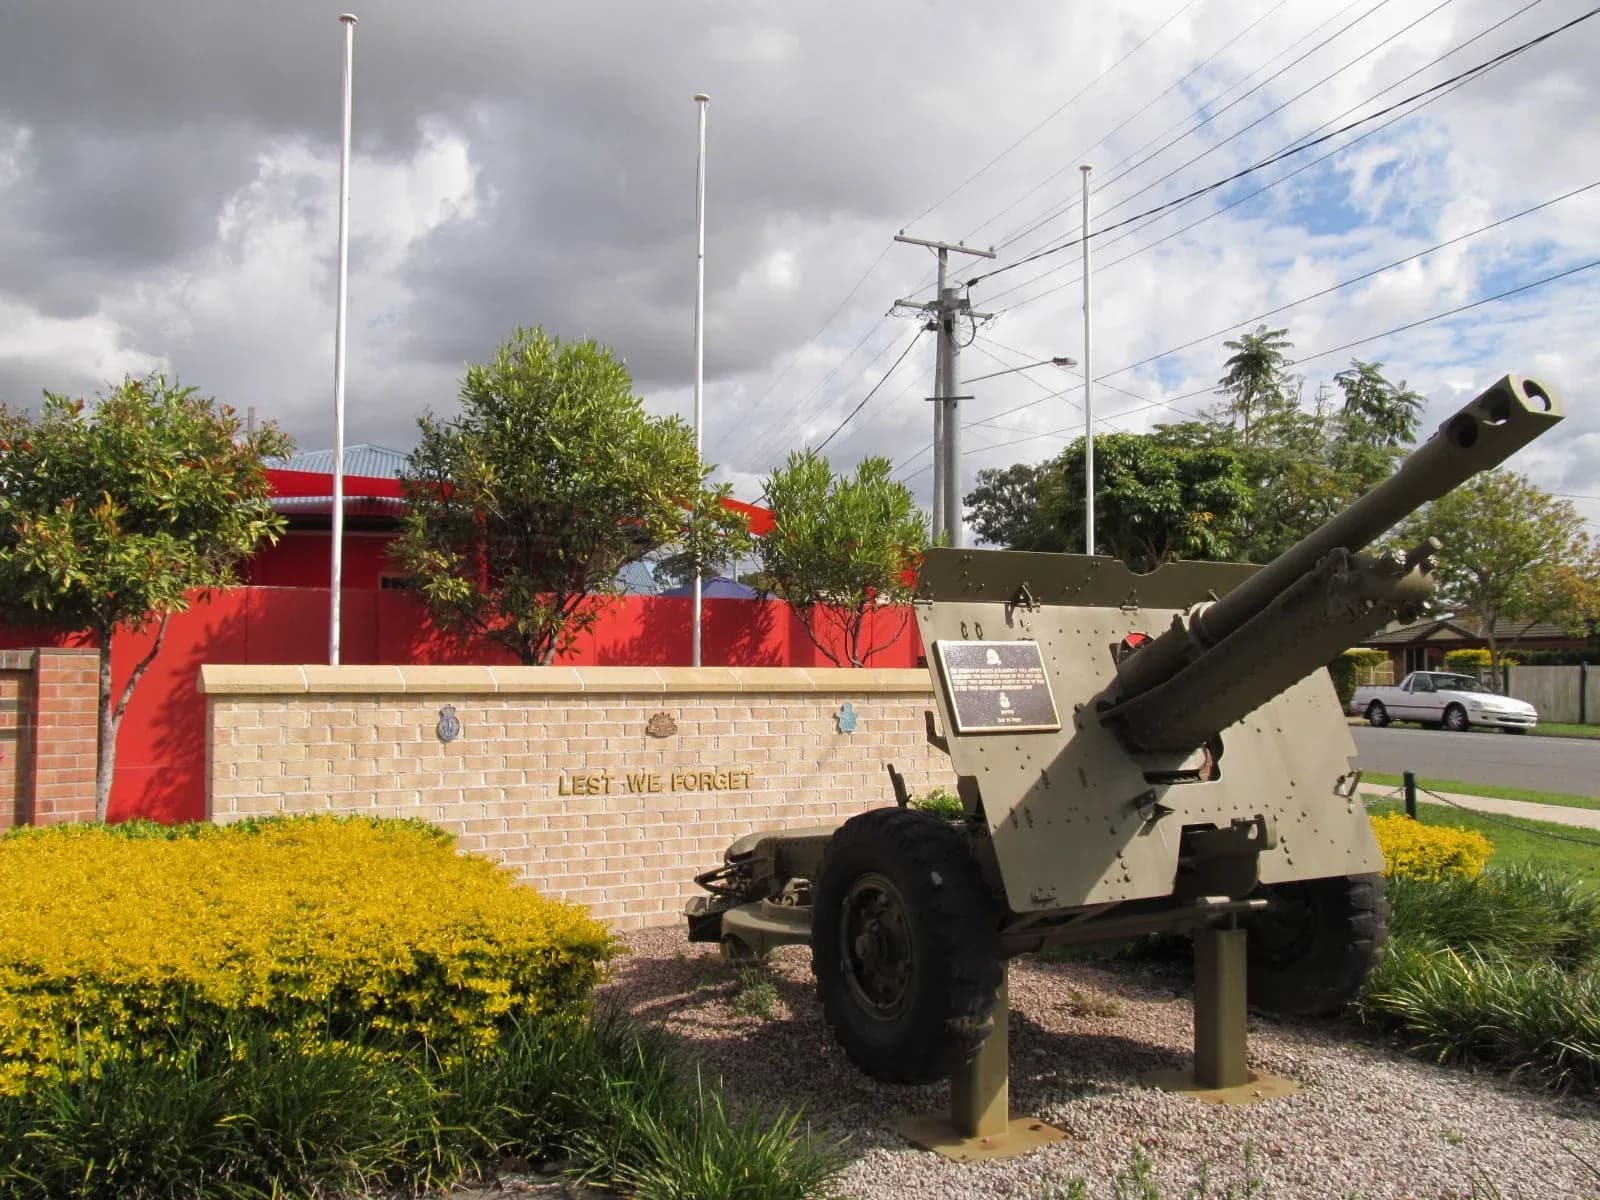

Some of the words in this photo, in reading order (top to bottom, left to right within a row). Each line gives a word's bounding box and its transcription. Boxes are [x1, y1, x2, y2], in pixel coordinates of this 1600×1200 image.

[558, 774, 616, 796] LEST
[627, 773, 661, 793] WE
[671, 770, 755, 792] FORGET
